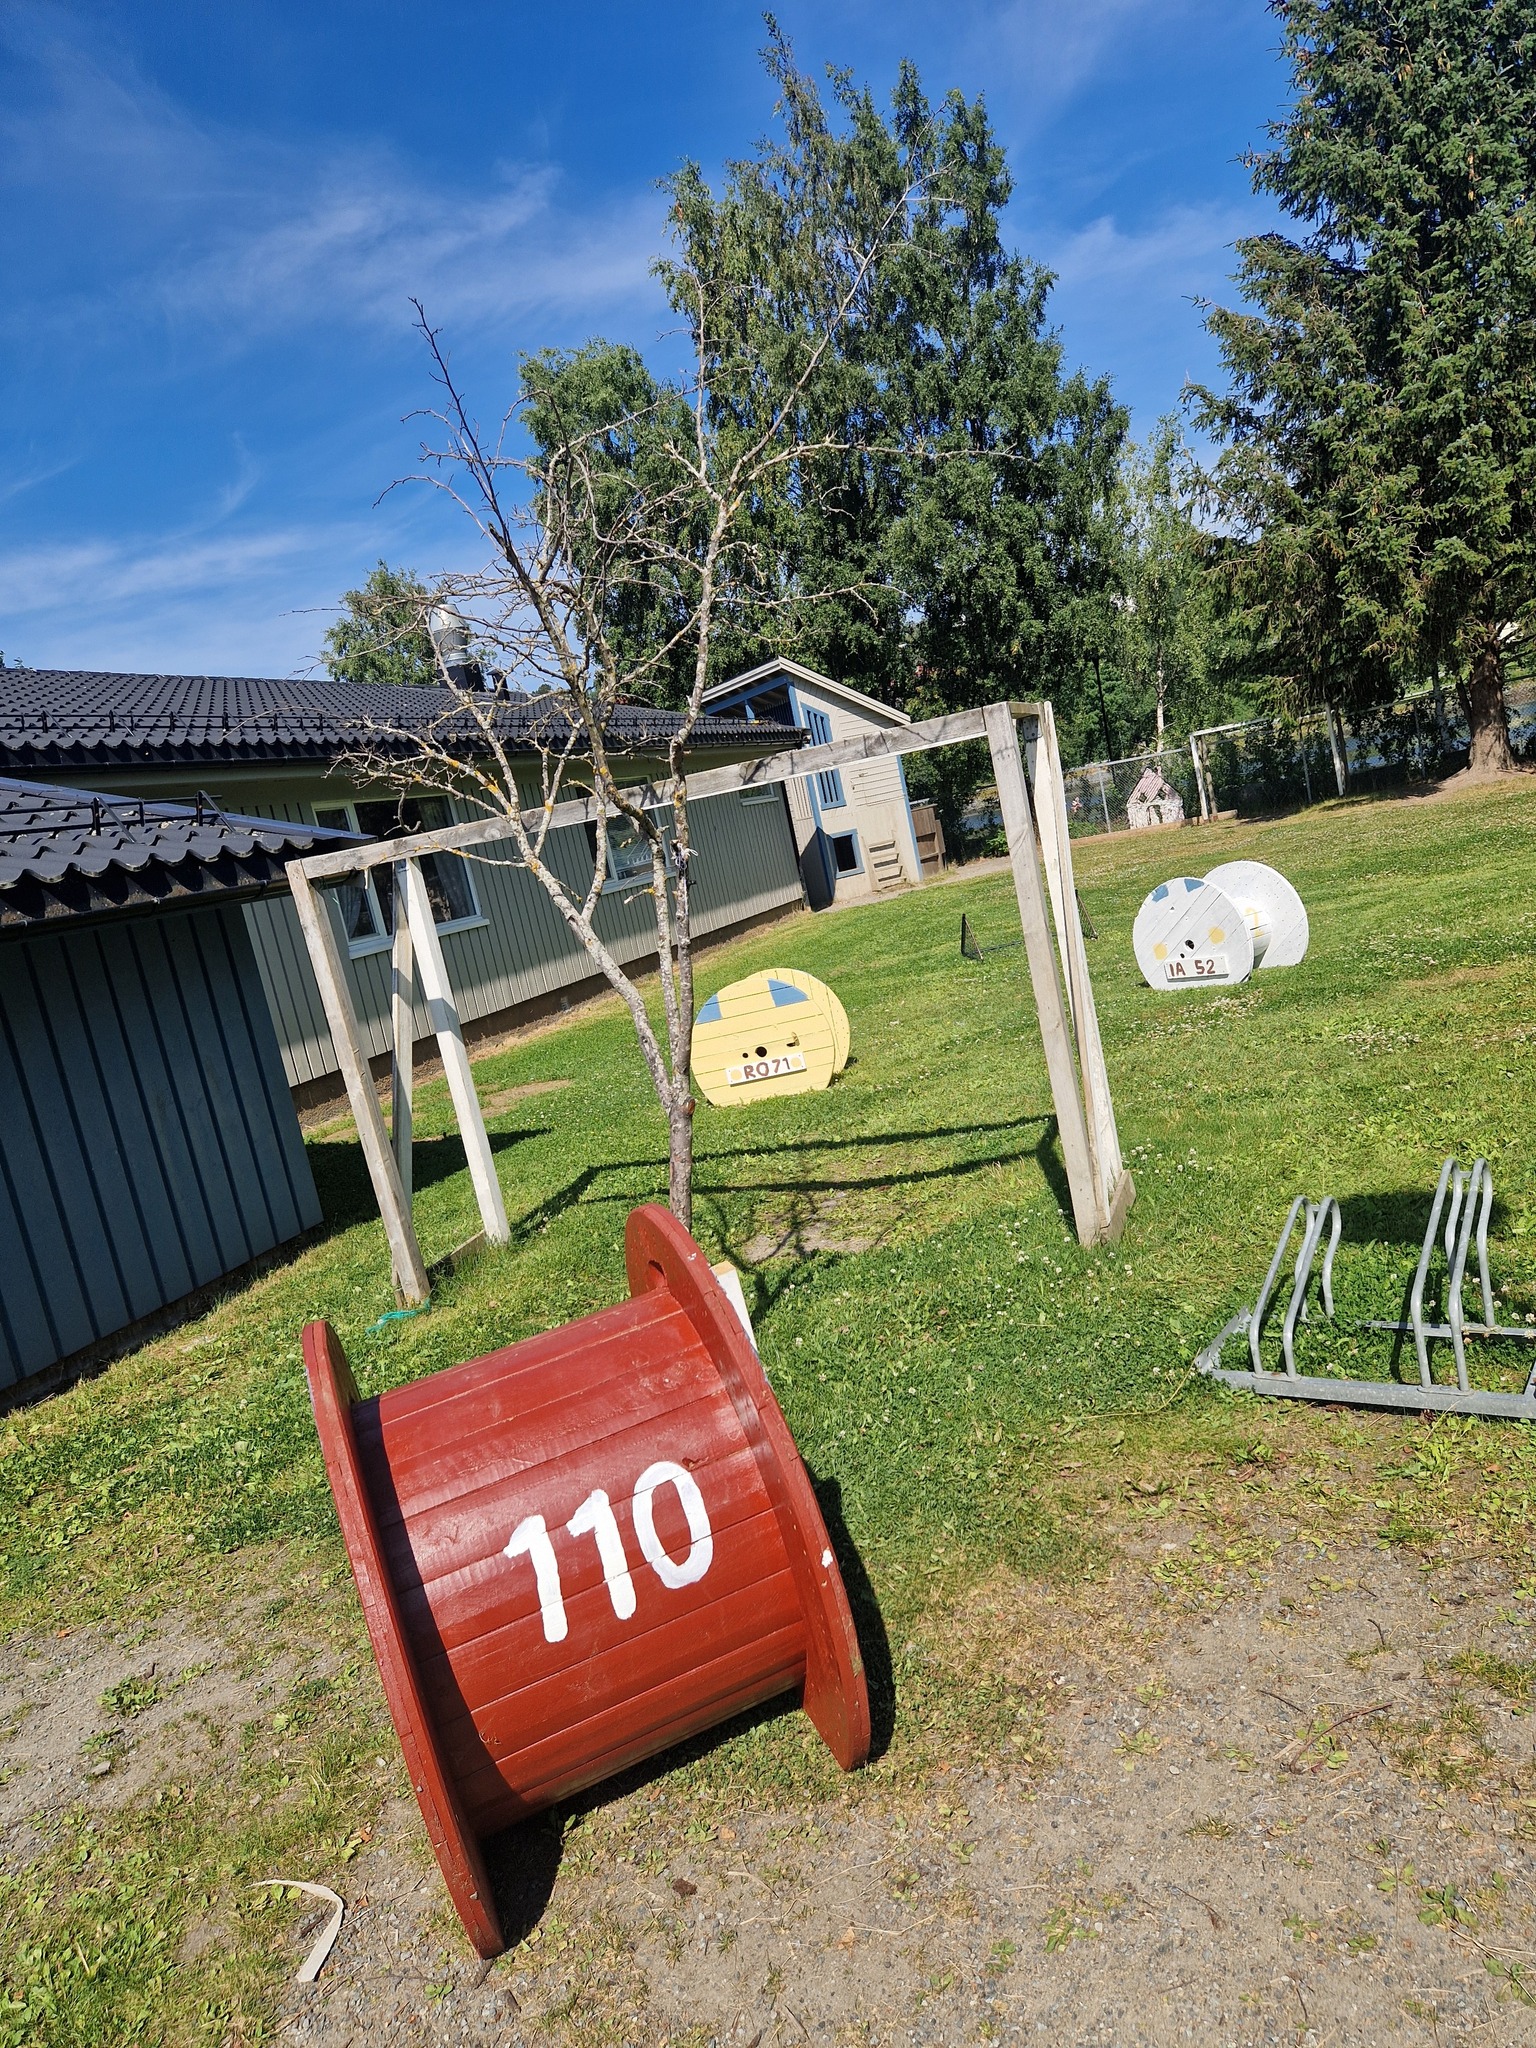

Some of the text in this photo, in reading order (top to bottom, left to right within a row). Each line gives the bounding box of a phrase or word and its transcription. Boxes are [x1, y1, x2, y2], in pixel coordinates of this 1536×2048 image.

[1169, 959, 1216, 978] IA 52
[502, 1460, 714, 1643] 110
